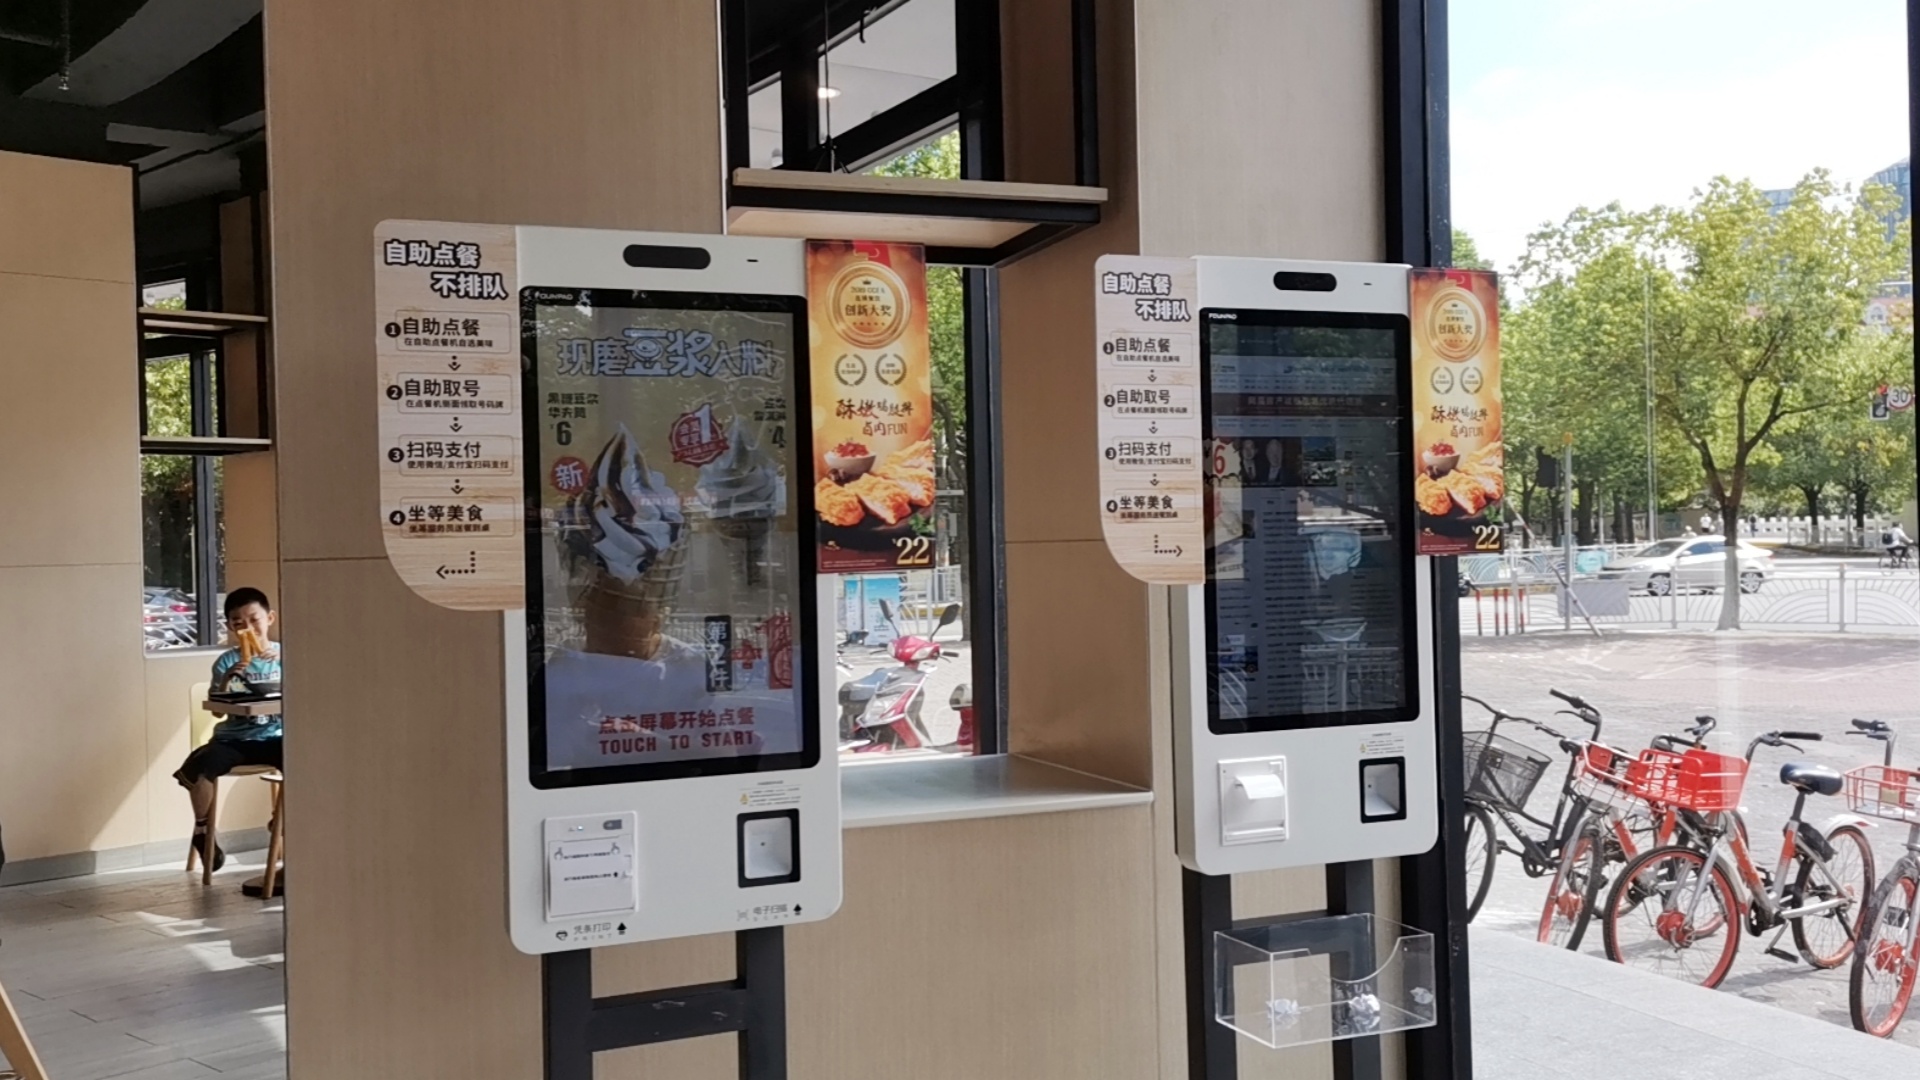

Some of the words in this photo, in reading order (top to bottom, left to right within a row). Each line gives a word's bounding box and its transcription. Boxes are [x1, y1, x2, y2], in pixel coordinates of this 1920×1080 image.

[384, 240, 481, 268] 自助点餐
[431, 271, 508, 300] 不排队
[1102, 272, 1171, 295] 自助点餐
[845, 304, 892, 317] 创新大奖
[1135, 299, 1191, 322] 不排队
[403, 318, 480, 337] 自助点餐
[1115, 337, 1170, 353] 自助点餐
[404, 379, 480, 397] 自助取号
[1117, 389, 1171, 405] 自助取号
[1891, 390, 1909, 403] 30
[407, 441, 481, 458] 扫码支付
[1118, 441, 1172, 457] 扫码支付
[554, 462, 583, 489] 新
[1120, 495, 1173, 510] 坐等美食
[408, 505, 483, 522] 坐等美食
[599, 707, 755, 735] 点击屏幕开始点餐
[599, 736, 656, 756] TOUCH
[669, 734, 689, 750] TO
[702, 730, 755, 747] START
